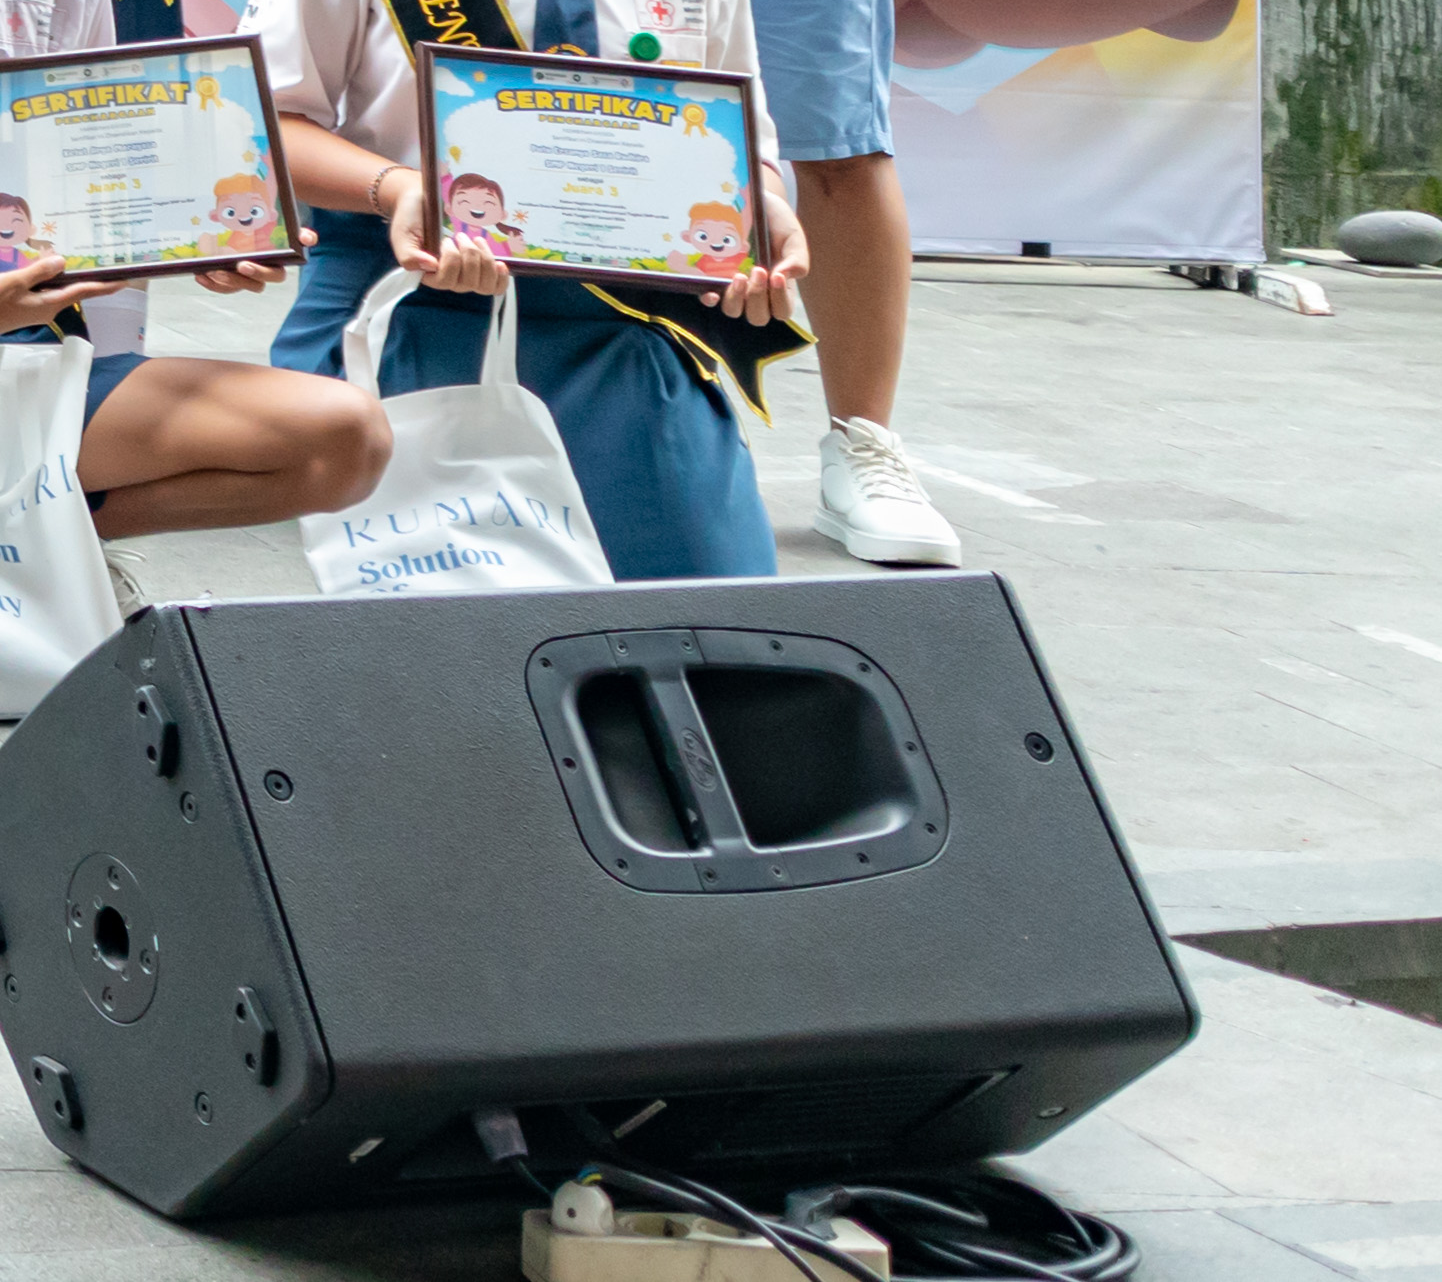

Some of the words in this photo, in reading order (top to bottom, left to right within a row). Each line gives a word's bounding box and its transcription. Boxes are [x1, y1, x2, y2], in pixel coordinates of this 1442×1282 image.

[12, 82, 191, 123] SERTIFIKAT
[496, 89, 678, 126] SERTIFIKAT
[343, 491, 577, 549] KUMARI
[358, 542, 505, 586] Solution
